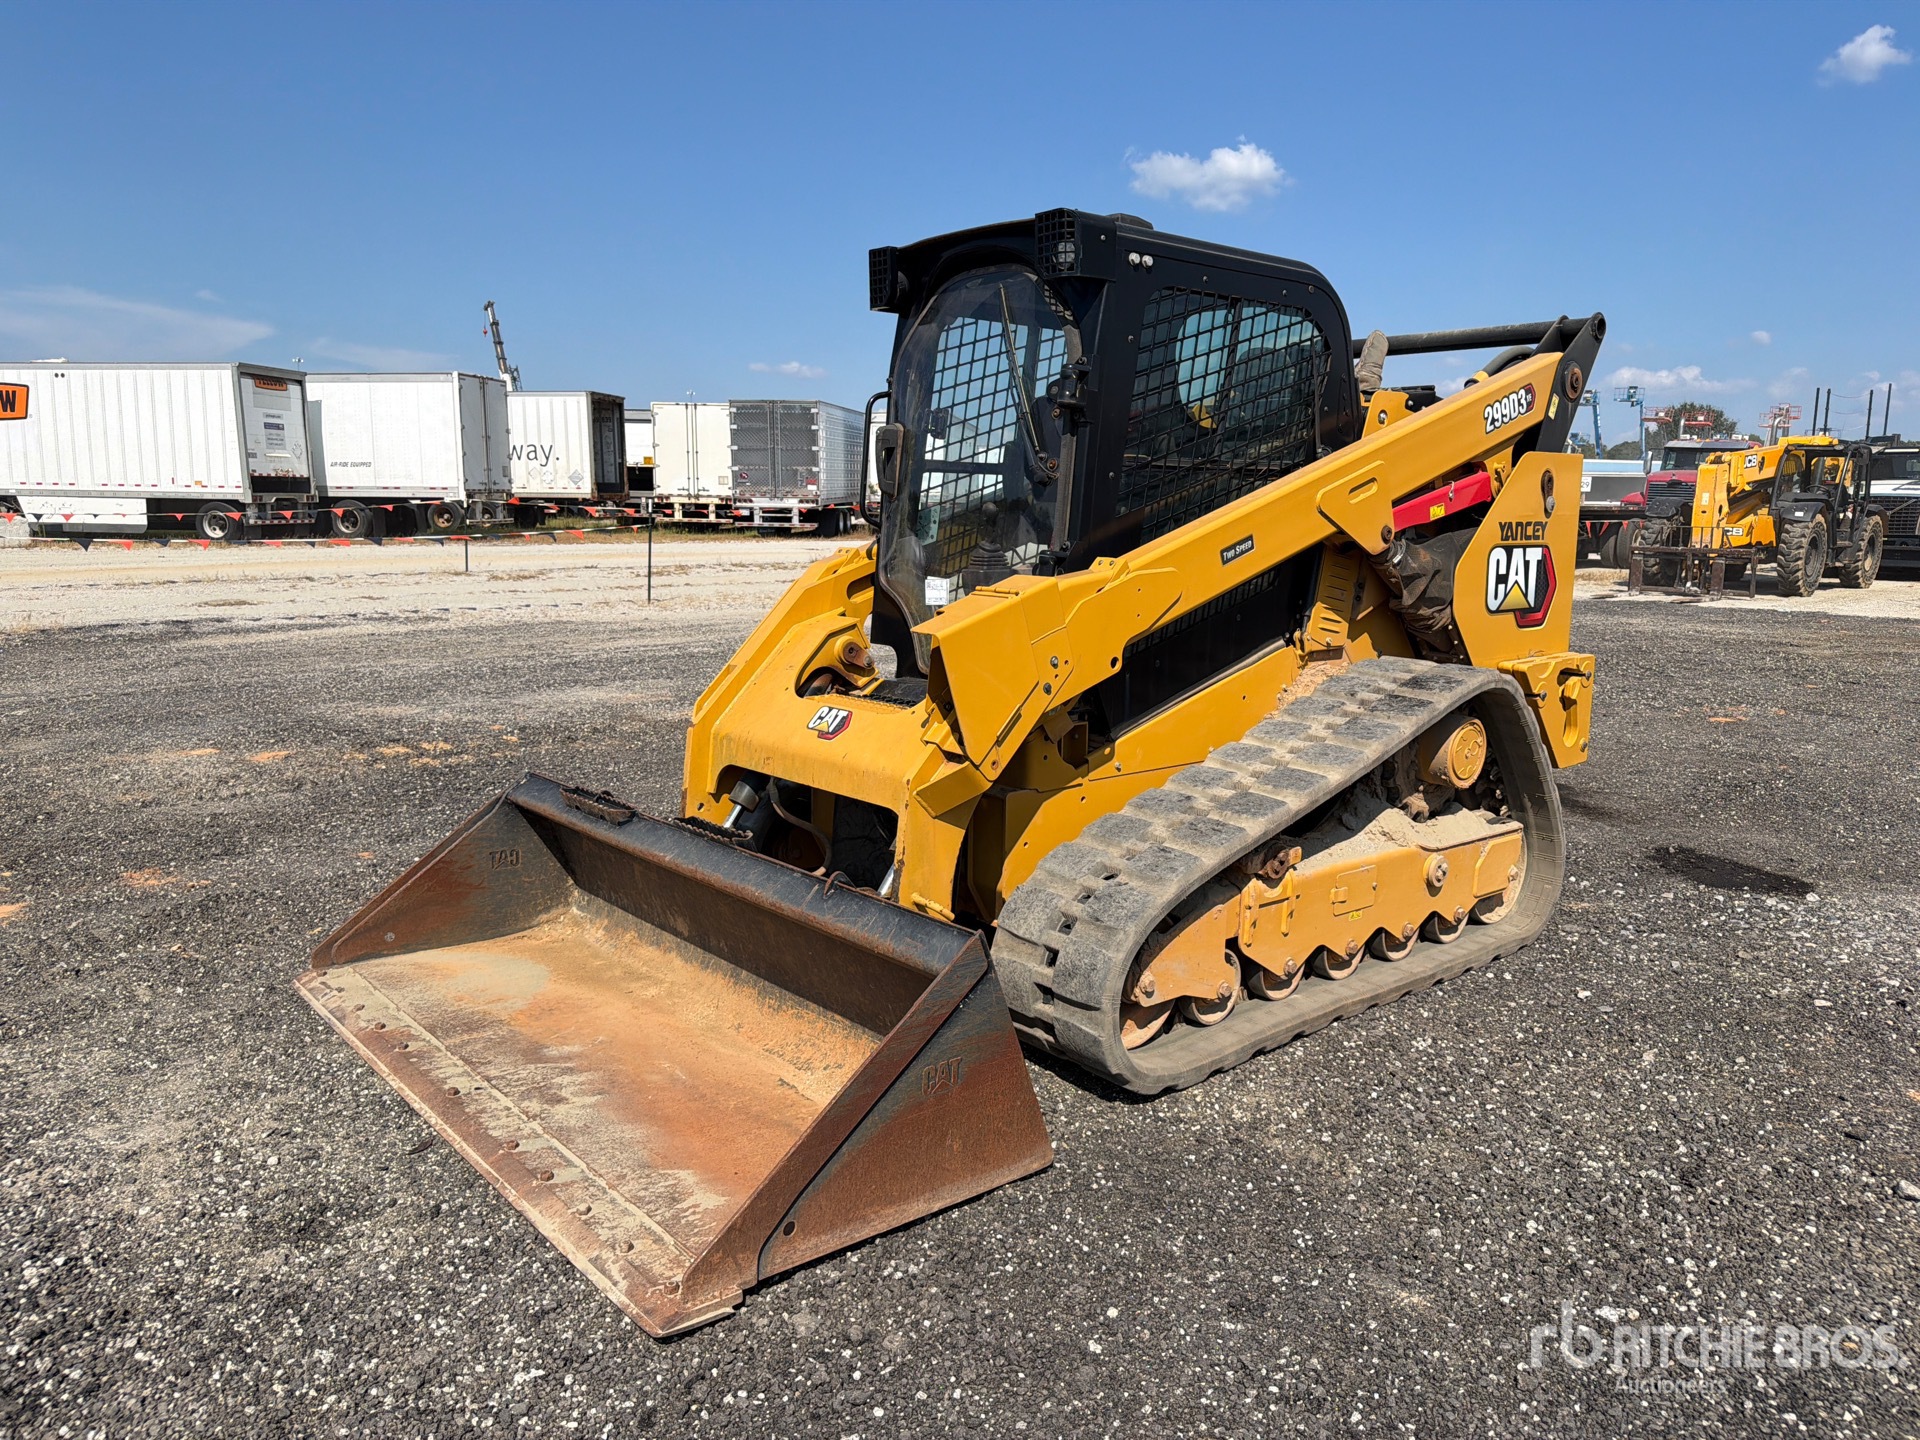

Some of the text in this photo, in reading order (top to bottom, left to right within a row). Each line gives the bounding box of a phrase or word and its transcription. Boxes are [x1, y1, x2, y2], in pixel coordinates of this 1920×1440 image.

[1484, 388, 1527, 433] 299D3
[511, 444, 559, 467] way.
[1498, 521, 1549, 541] YANCEY
[1723, 527, 1743, 536] CB
[1487, 546, 1543, 612] CAT
[808, 706, 849, 733] CAT
[922, 1056, 962, 1095] CAT
